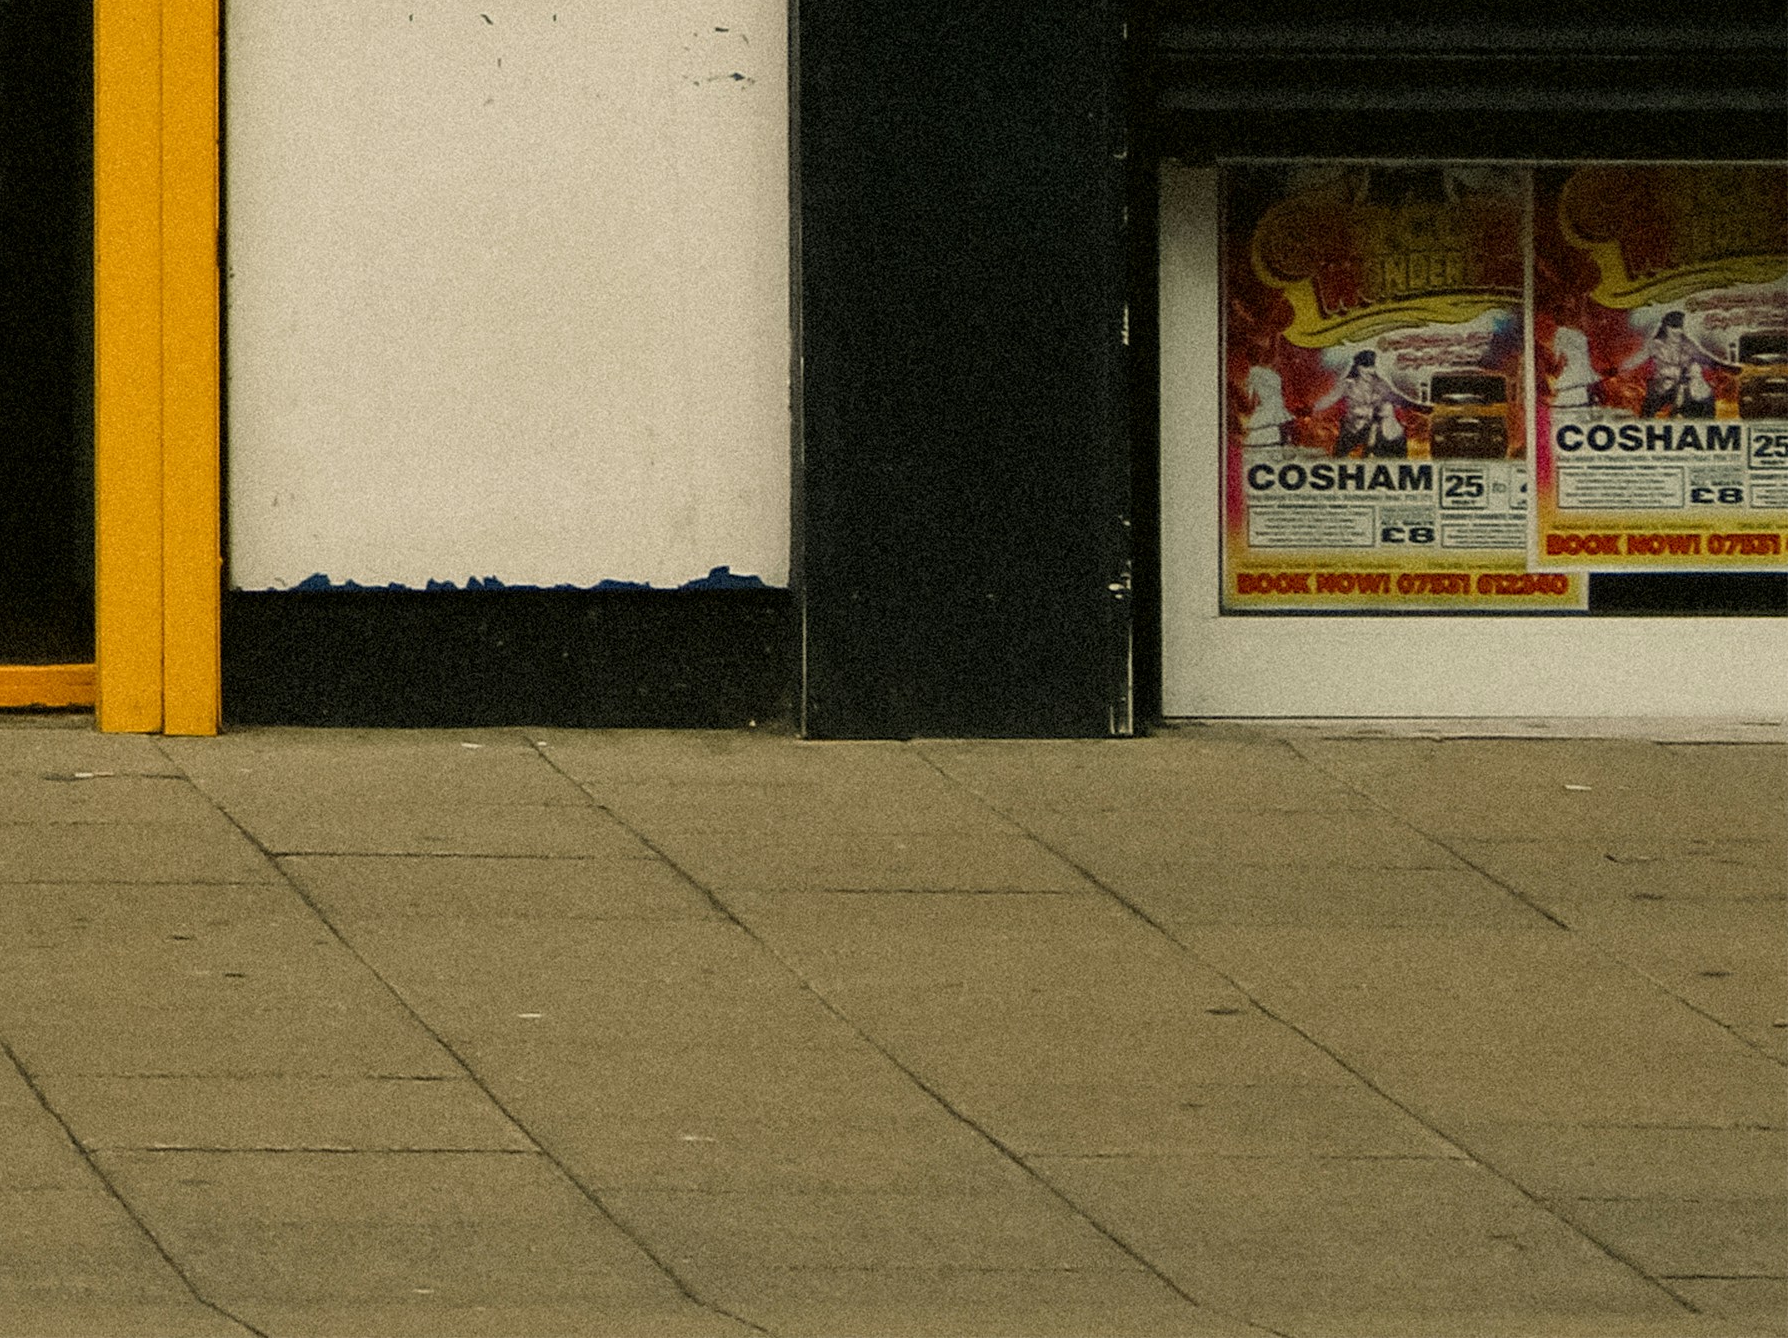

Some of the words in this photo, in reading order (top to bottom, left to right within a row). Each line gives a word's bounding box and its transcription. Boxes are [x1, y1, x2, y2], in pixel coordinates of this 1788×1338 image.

[1556, 424, 1741, 451] COSHAM
[1753, 435, 1788, 458] 25
[1247, 464, 1433, 491] COSHAM
[1444, 475, 1484, 498] 25
[1690, 487, 1744, 504] £8
[1381, 527, 1435, 544] £8
[1546, 533, 1620, 556] BOOK
[1626, 533, 1701, 556] NOW!
[1237, 573, 1311, 595] BOOK
[1315, 573, 1391, 595] NOW!
